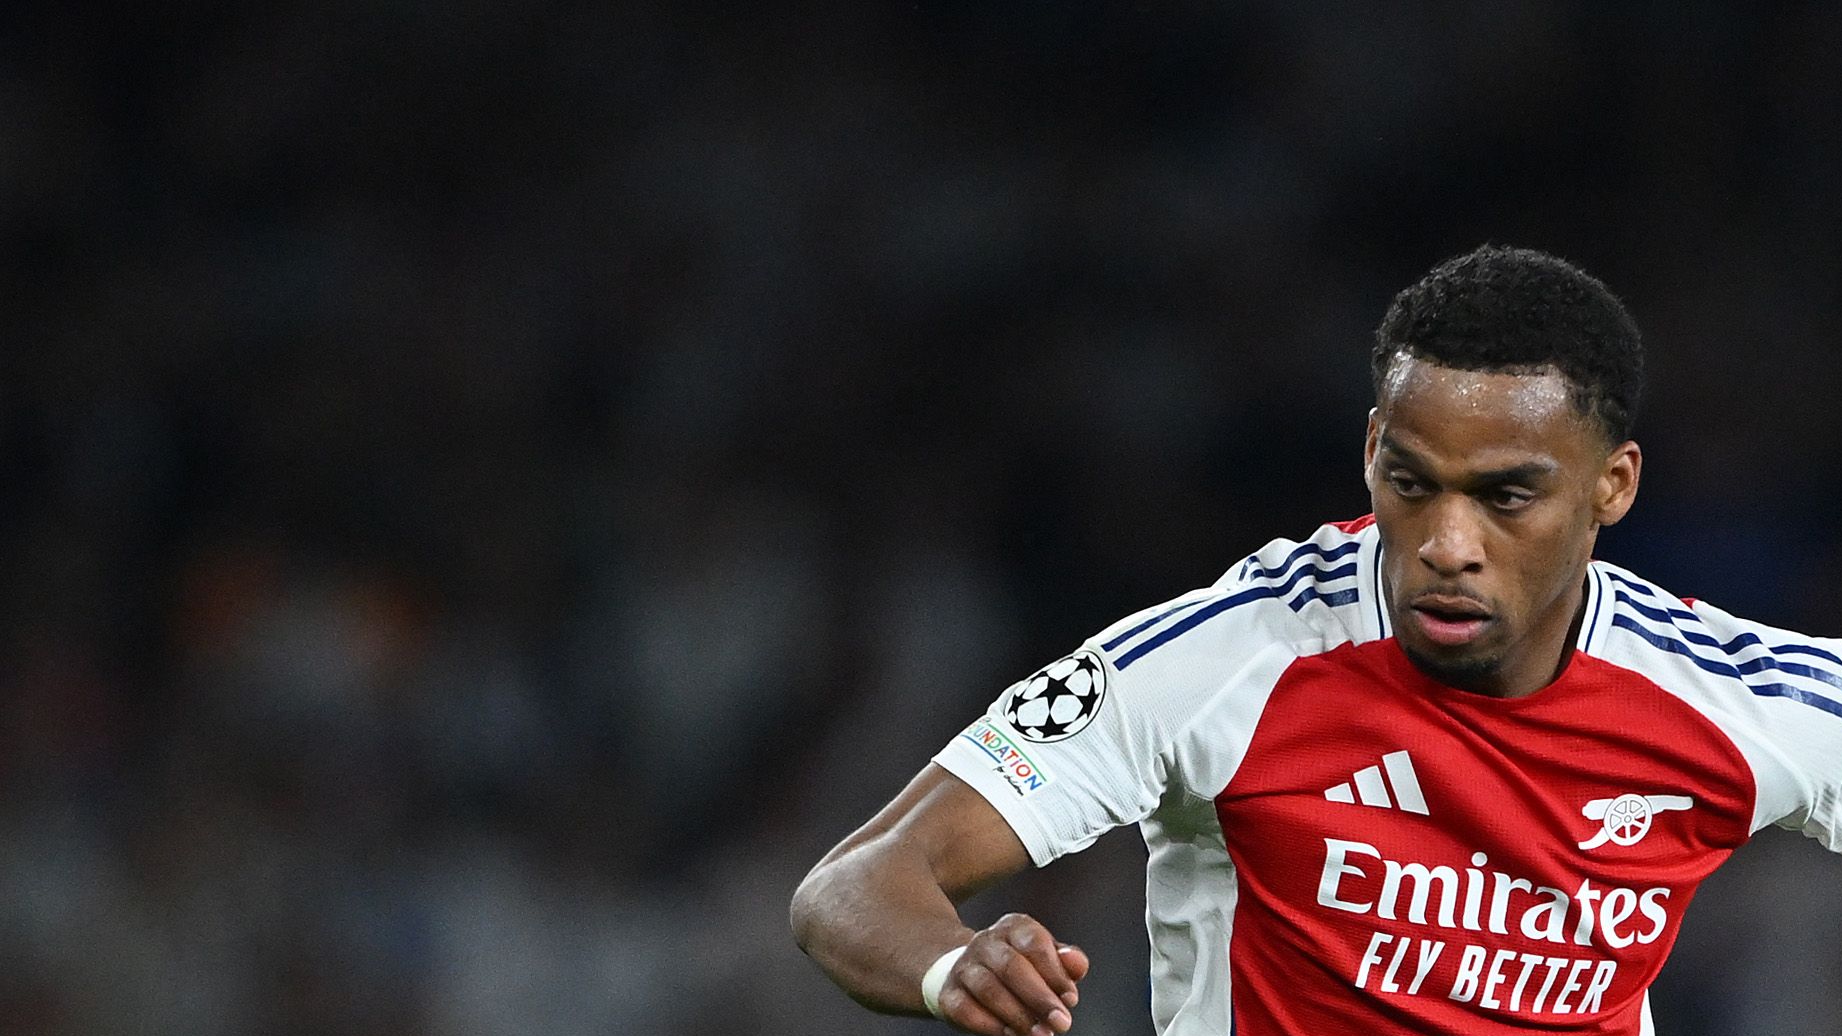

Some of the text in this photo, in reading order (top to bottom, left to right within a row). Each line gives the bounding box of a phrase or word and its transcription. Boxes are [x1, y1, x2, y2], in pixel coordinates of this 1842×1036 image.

[1316, 838, 1671, 949] Emirates
[1355, 932, 1617, 1014] FLY BETTER
